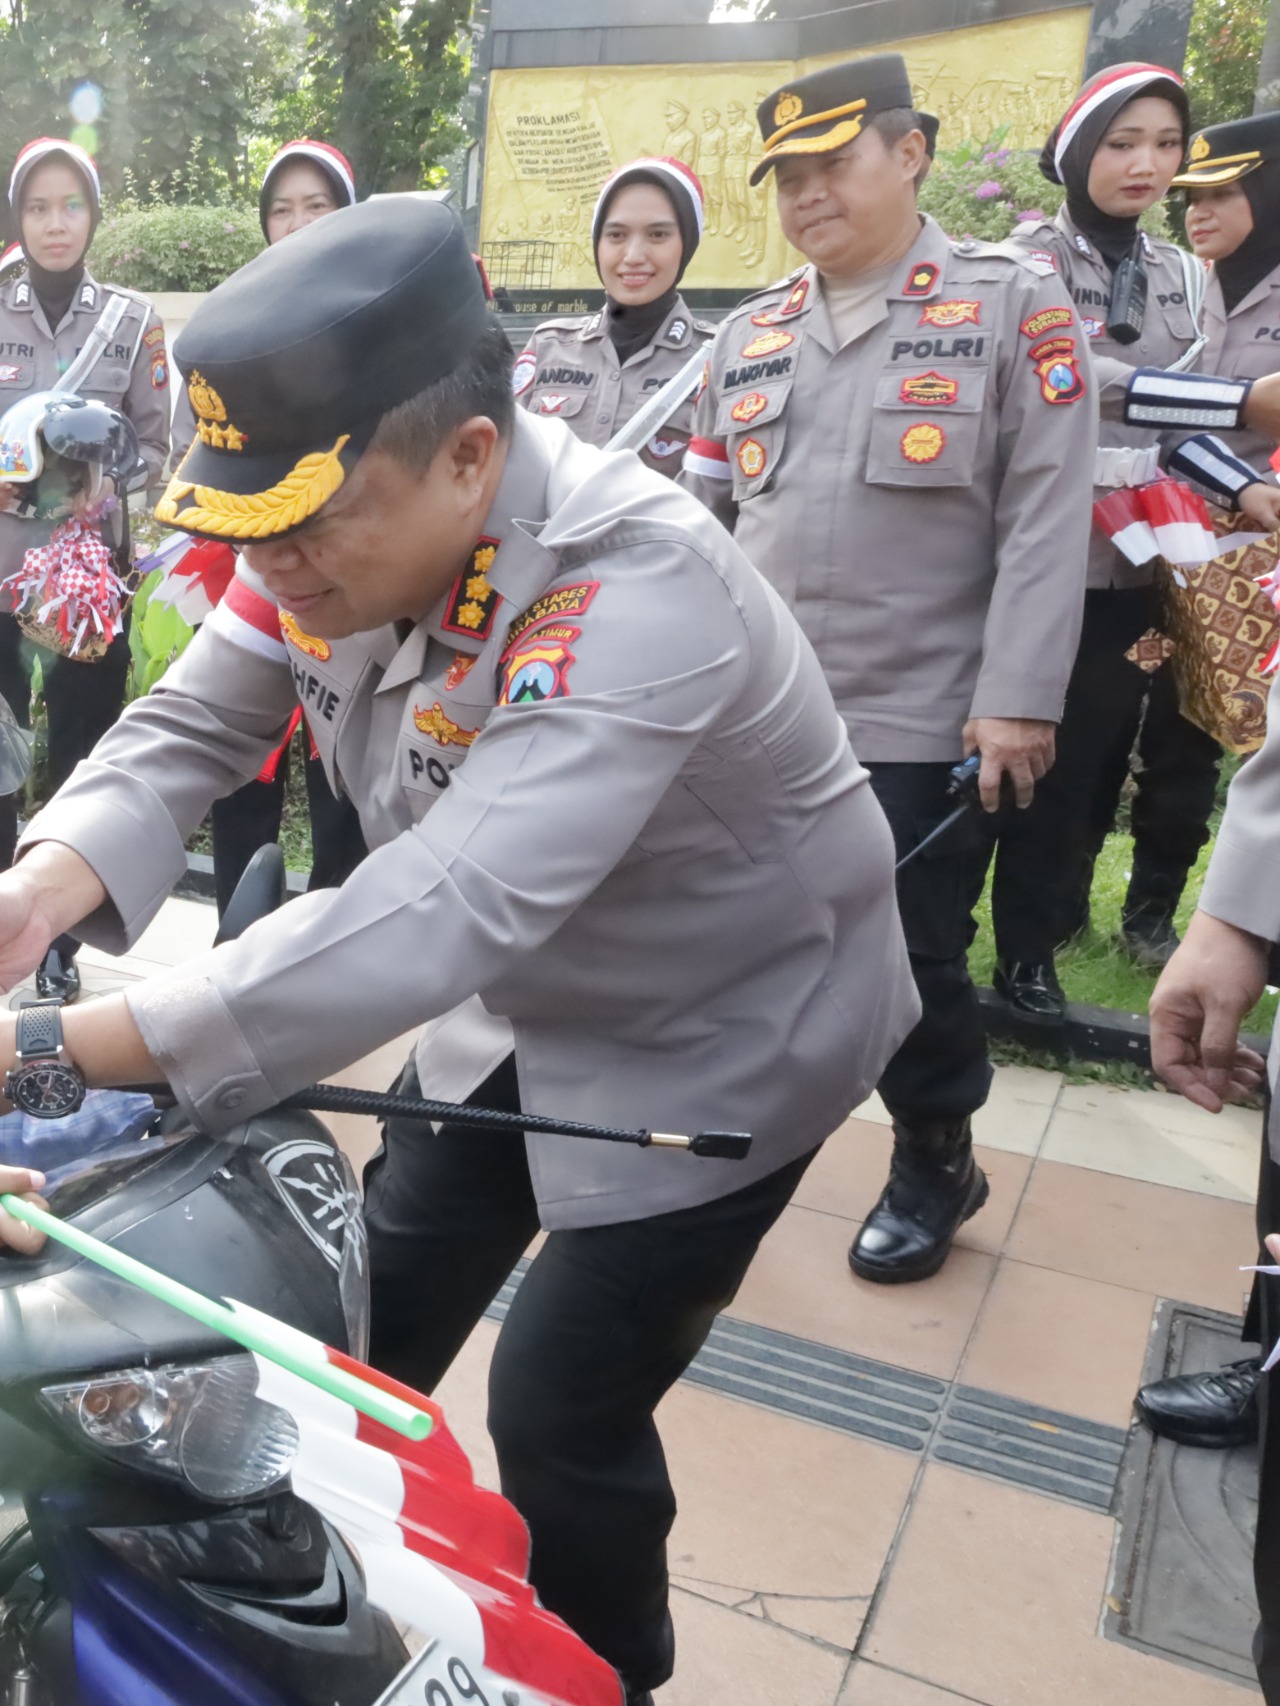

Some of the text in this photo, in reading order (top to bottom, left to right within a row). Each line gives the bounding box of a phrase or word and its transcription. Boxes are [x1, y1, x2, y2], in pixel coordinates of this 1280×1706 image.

[516, 111, 581, 126] PROKLAMASI
[514, 303, 537, 312] ouse
[541, 301, 554, 312] of
[557, 299, 588, 312] marble
[890, 337, 985, 361] POLRI
[536, 367, 594, 386] ANDIN
[541, 628, 573, 638] TIMUR
